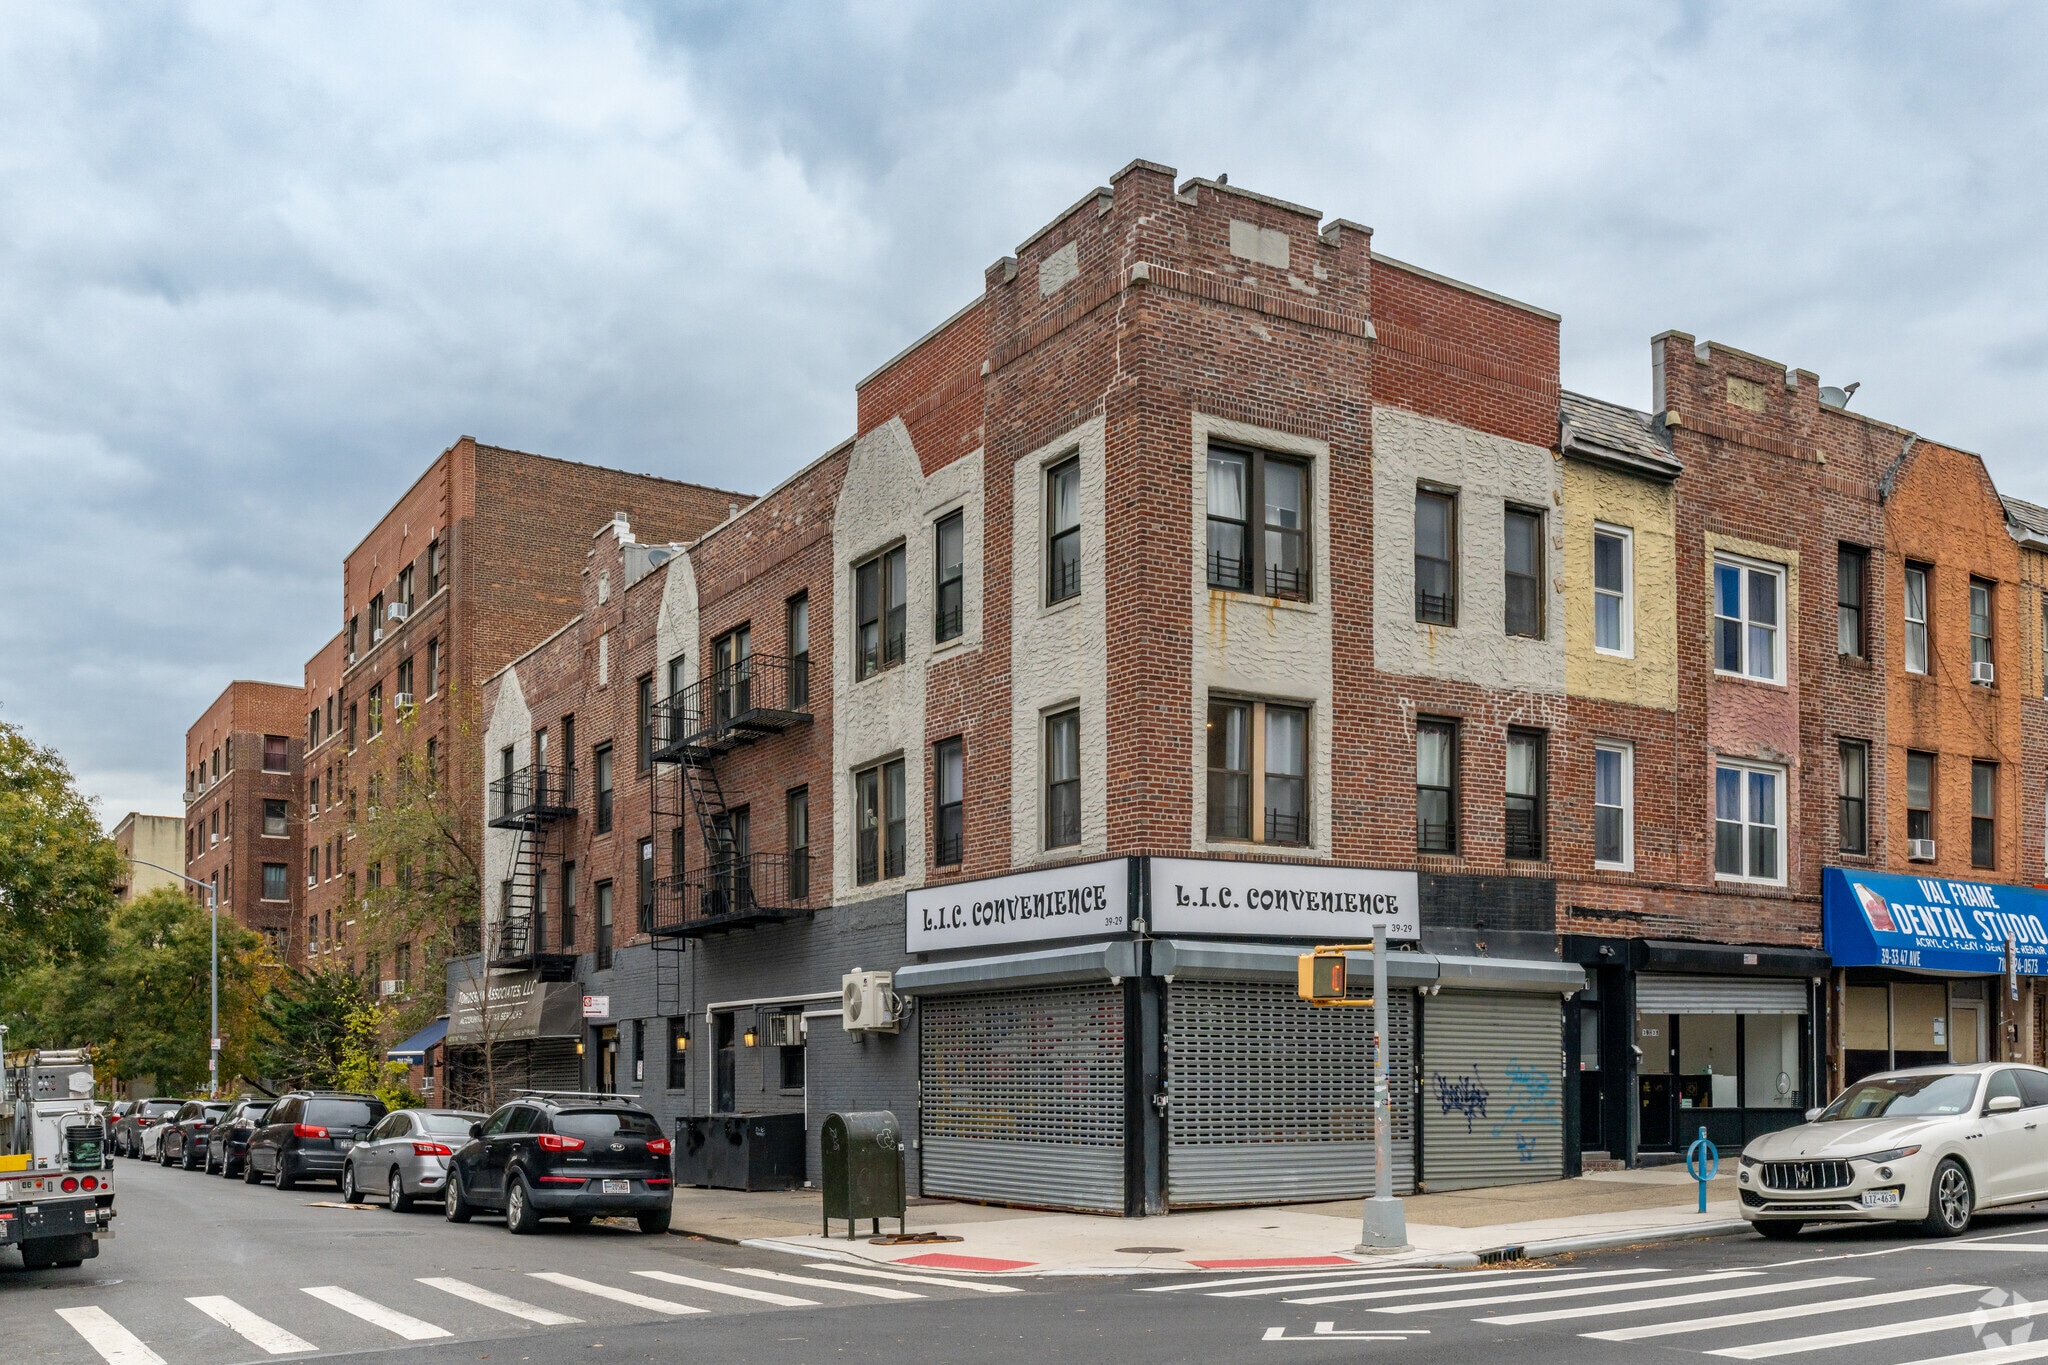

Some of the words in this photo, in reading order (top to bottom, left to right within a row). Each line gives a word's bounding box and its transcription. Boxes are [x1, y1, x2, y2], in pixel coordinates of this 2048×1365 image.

[922, 905, 967, 932] L.I.C.
[972, 885, 1107, 927] CONVENIENCE
[1175, 884, 1239, 909] L.I.C.
[1246, 888, 1399, 915] CONVENIENCE
[1917, 879, 1951, 905] VAL
[1947, 882, 2000, 909] FRAME
[1105, 916, 1123, 927] 39-29
[1391, 923, 1413, 933] 39-29
[1891, 903, 1977, 940] DENTAL
[1973, 910, 2048, 945] STUDIO
[1881, 948, 1899, 964] 39-33
[1900, 950, 1908, 966] 47
[1909, 951, 1921, 967] AVE
